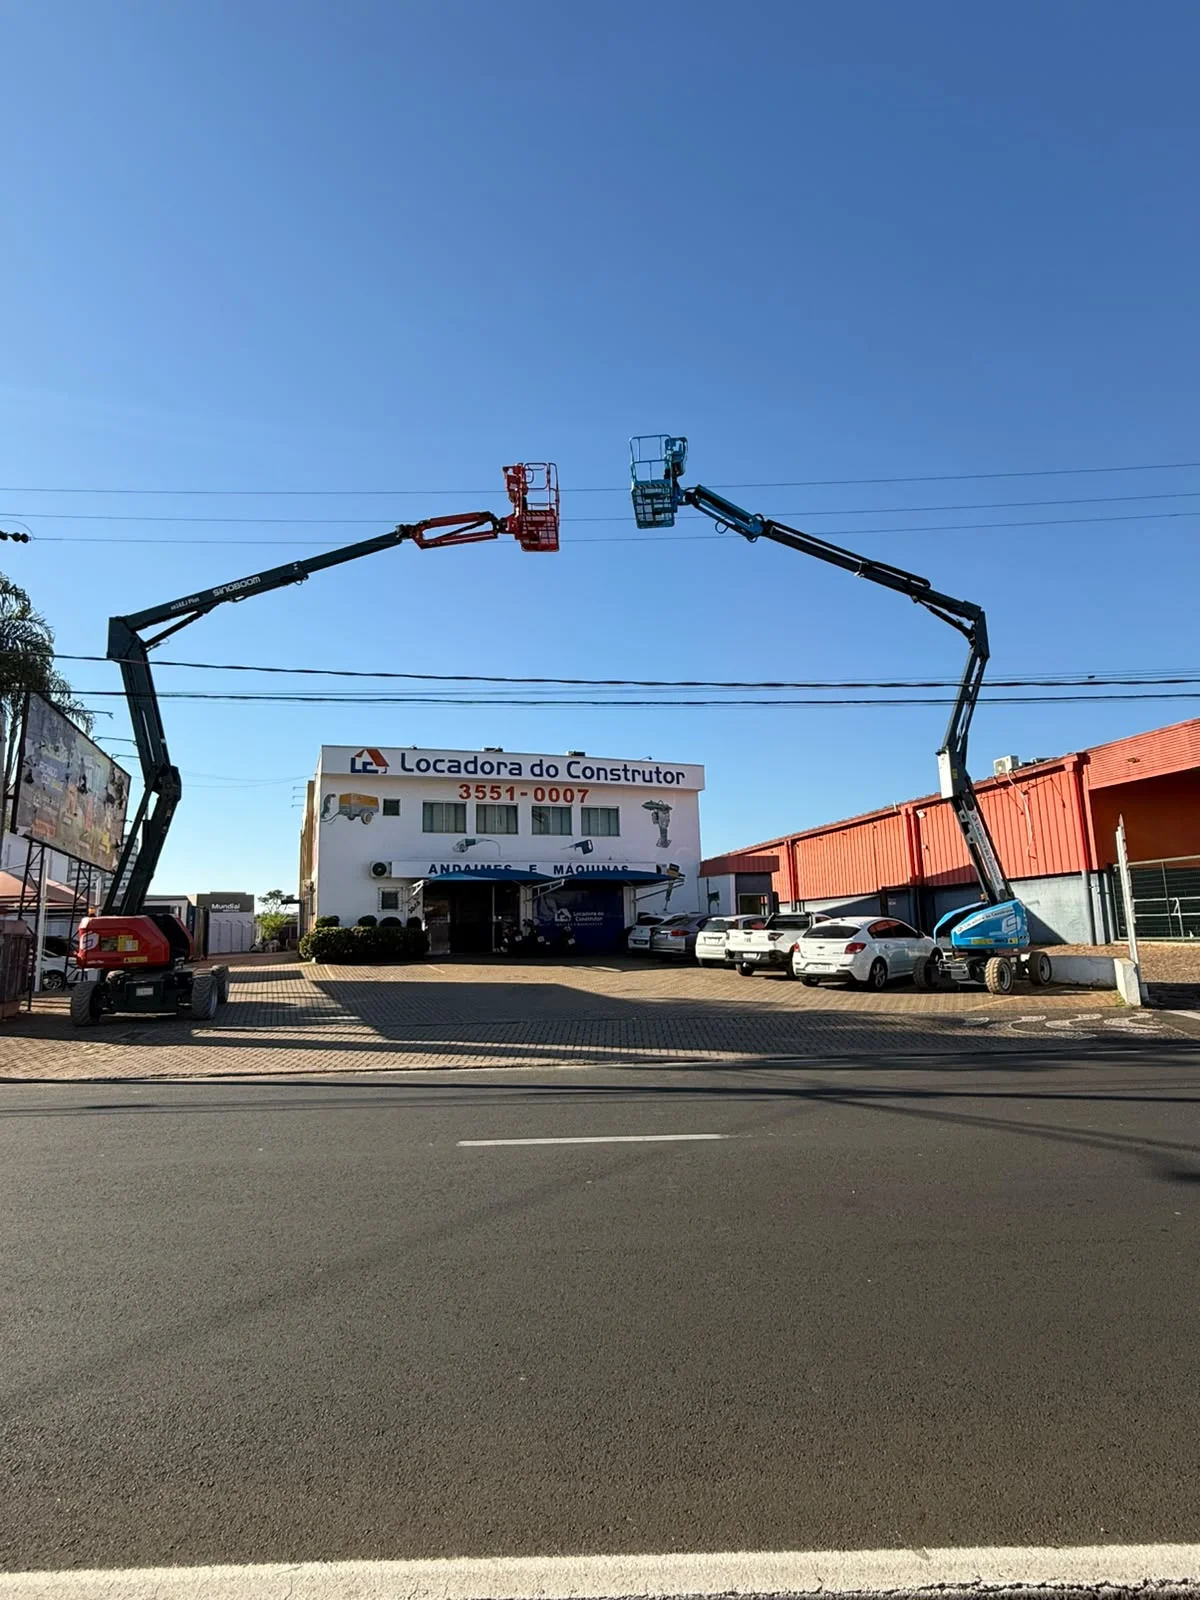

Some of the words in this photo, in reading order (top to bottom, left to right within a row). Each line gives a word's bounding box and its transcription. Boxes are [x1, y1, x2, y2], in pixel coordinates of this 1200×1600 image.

[401, 752, 523, 777] Locadora
[530, 759, 559, 778] do
[567, 761, 686, 785] Construtor
[458, 783, 590, 804] 3551-0007
